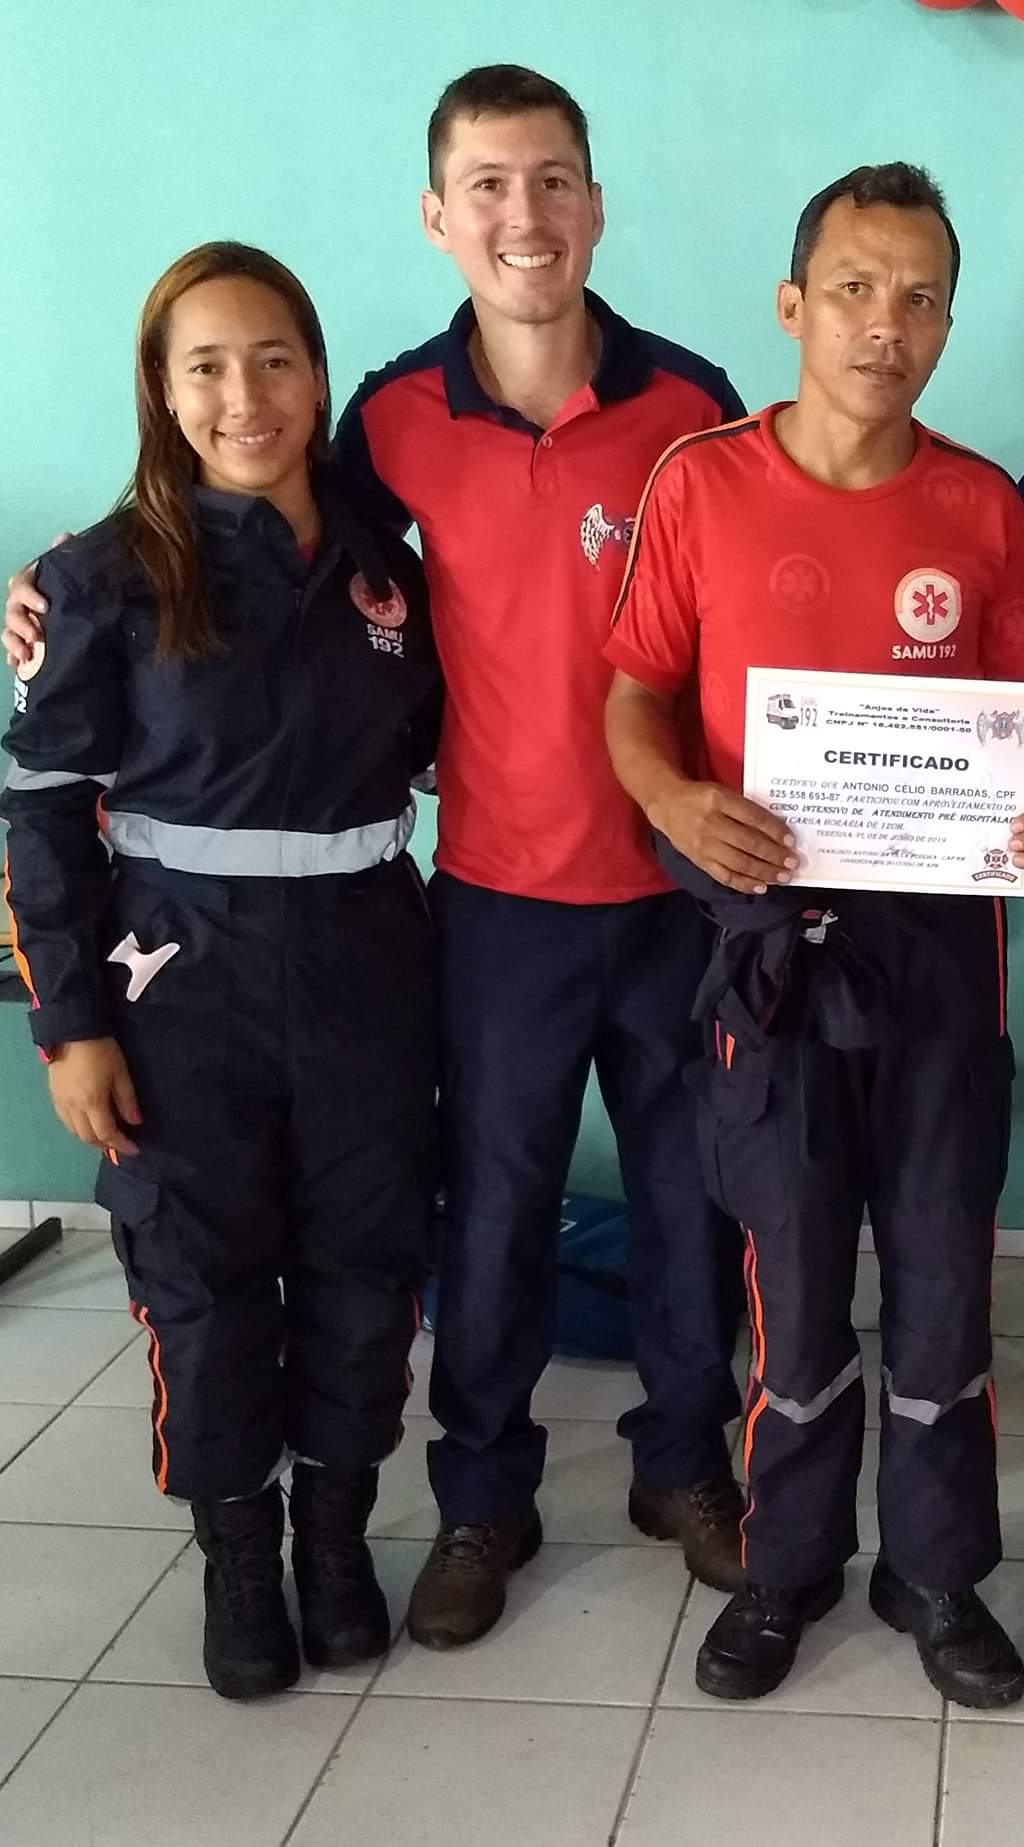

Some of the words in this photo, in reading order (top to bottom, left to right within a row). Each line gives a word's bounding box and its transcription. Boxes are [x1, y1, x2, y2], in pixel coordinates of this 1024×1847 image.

[367, 624, 403, 643] SAMU
[368, 636, 405, 658] 192
[892, 645, 937, 659] SAMU
[938, 645, 956, 658] 192
[800, 707, 818, 727] 192
[823, 750, 970, 772] CERTIFICADO
[770, 777, 816, 788] CERTIFICO
[821, 780, 839, 789] QUE
[842, 782, 889, 792] ANTONIO
[894, 781, 925, 794] CÉLIO
[931, 786, 991, 799] BARRADAS,
[996, 790, 1016, 799] CPF
[769, 802, 799, 811] CURSO
[802, 805, 849, 815] INTENSIVO
[851, 807, 864, 816] DE
[871, 809, 935, 819] ATENDIMENTO
[938, 811, 957, 821] PRÉ
[846, 795, 900, 805] PARTICIPOU
[901, 798, 920, 806] COM
[922, 799, 1003, 811] APROVEITAMENTO
[1004, 803, 1017, 811] DO
[789, 816, 821, 825] CARGA
[866, 820, 880, 829] DE
